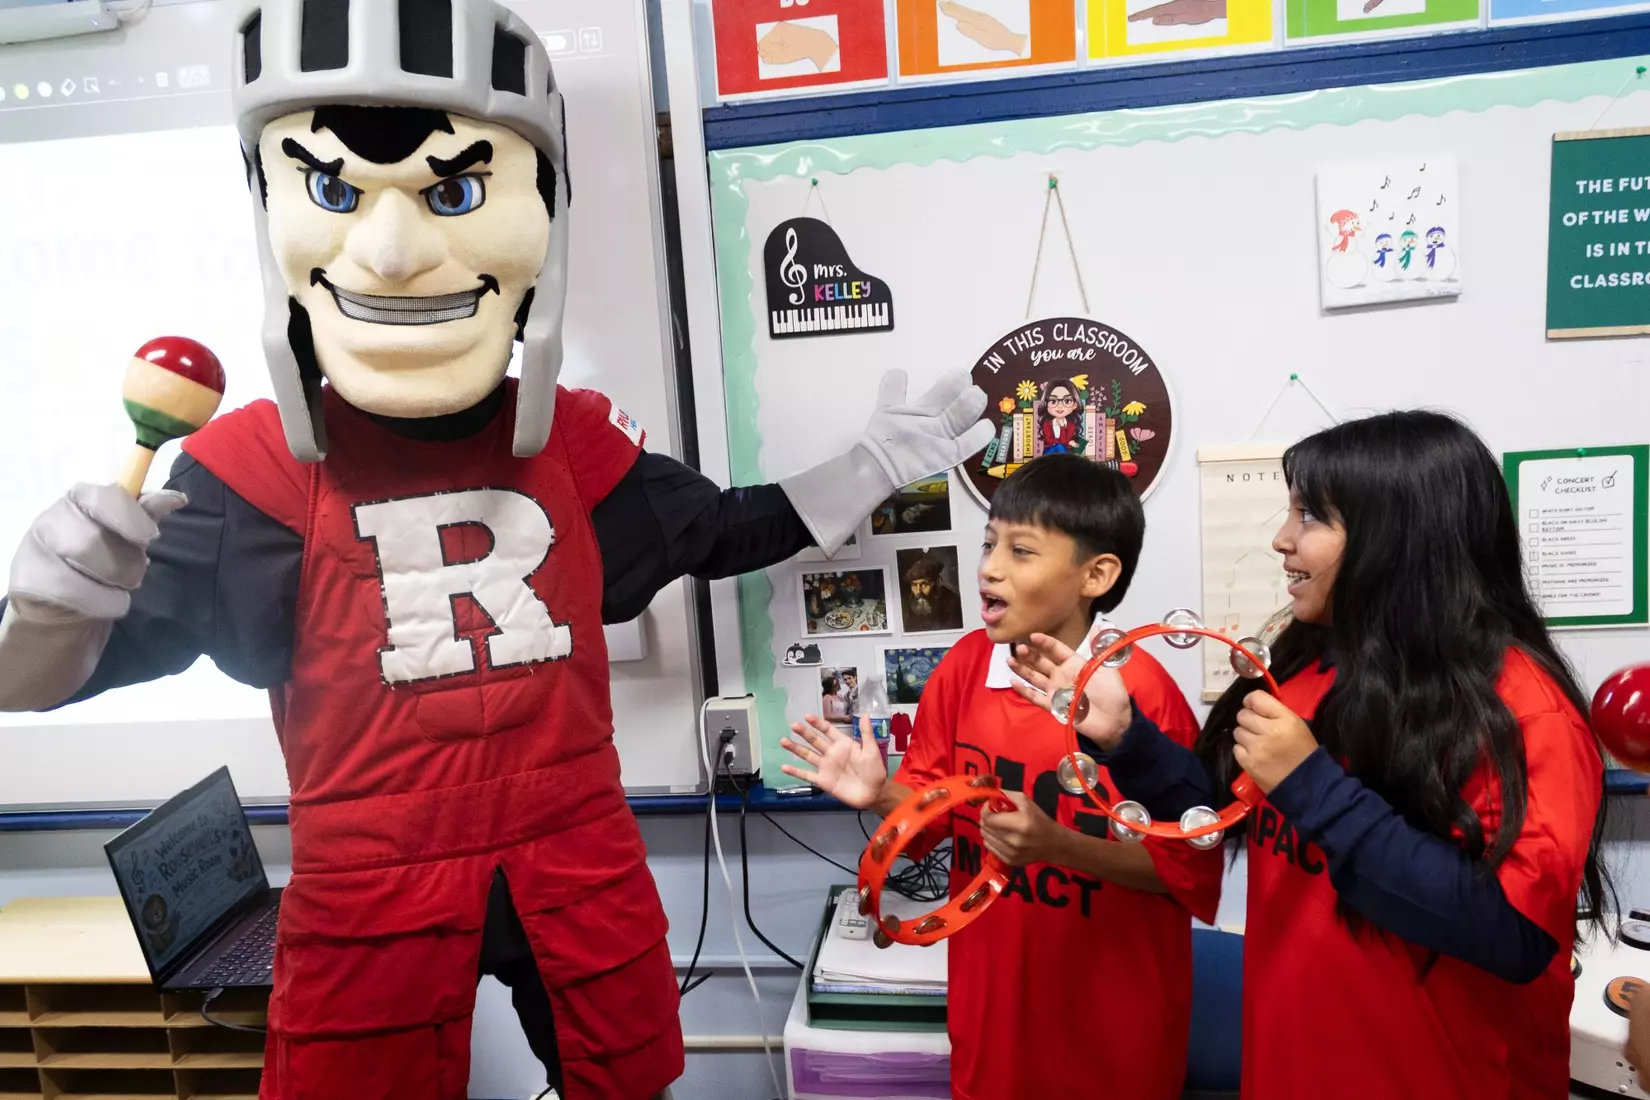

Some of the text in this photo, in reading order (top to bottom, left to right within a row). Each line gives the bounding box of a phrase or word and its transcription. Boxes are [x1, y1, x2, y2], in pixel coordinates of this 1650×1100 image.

[1576, 178, 1613, 194] THE
[1562, 211, 1589, 226] OF
[1591, 209, 1629, 224] THE
[1586, 240, 1650, 258] IS IN T
[814, 281, 872, 302] KELLEY
[983, 323, 1149, 376] IN THIS CLASSROOM
[1030, 346, 1097, 367] you are
[1556, 476, 1595, 485] CONCERT
[1554, 486, 1597, 495] CHECKLIST
[350, 487, 573, 686] R
[951, 835, 1103, 919] IMACT
